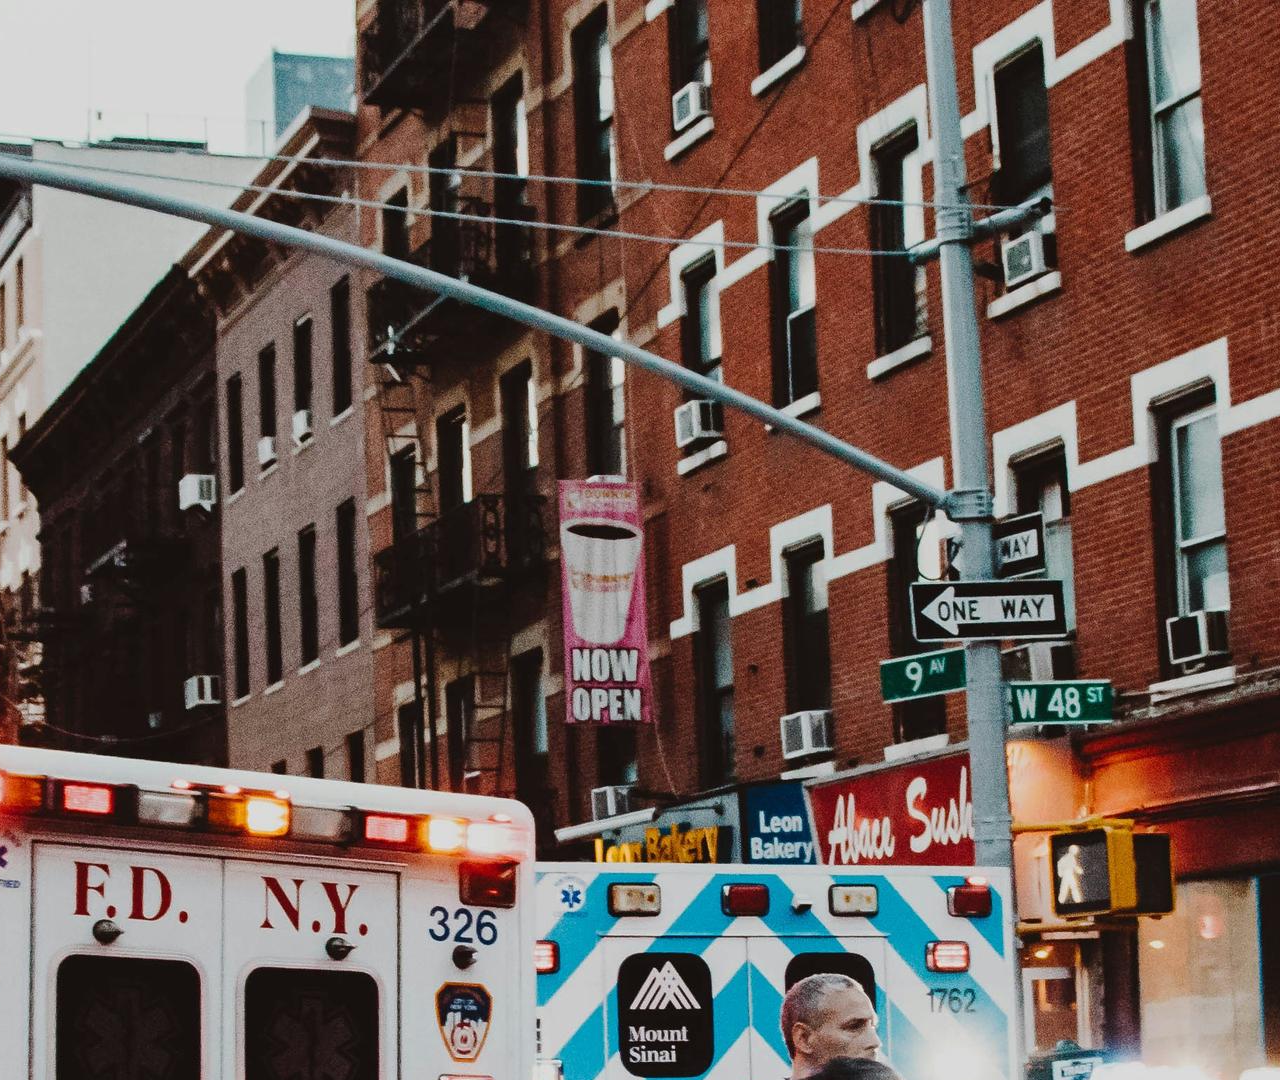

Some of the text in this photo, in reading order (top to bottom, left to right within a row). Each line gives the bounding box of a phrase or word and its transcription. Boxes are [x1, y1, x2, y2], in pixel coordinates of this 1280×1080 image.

[1000, 535, 1031, 558] WAY
[937, 597, 1045, 622] ONE WAY
[572, 648, 638, 682] NOW
[905, 657, 946, 692] 9 AV
[572, 688, 642, 721] OPEN
[1017, 686, 1104, 719] W 48 ST
[759, 810, 802, 834] Leon
[751, 837, 813, 863] Bakery
[73, 861, 369, 936] F.D. N.Y.
[429, 906, 498, 945] 326
[927, 987, 976, 1014] 1762
[628, 1025, 689, 1042] Mount
[629, 1045, 677, 1063] Sinai
